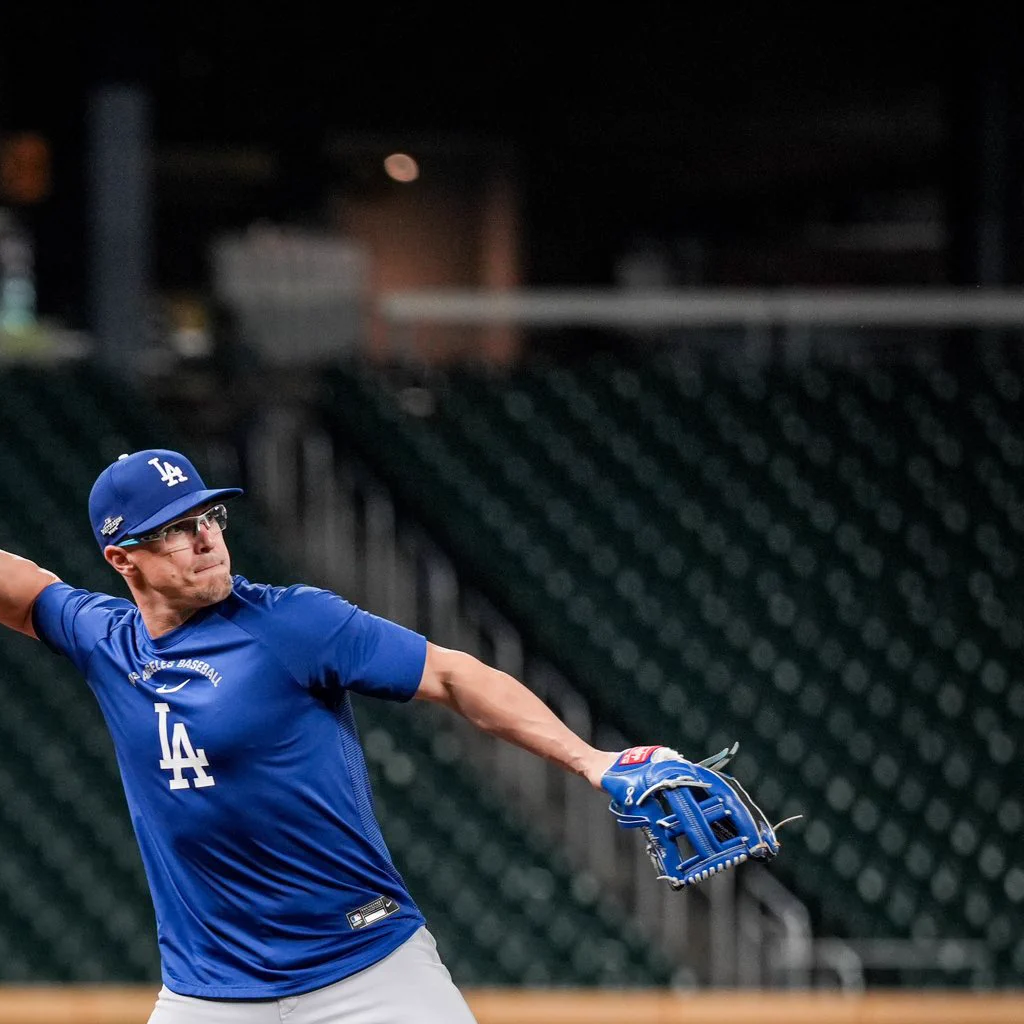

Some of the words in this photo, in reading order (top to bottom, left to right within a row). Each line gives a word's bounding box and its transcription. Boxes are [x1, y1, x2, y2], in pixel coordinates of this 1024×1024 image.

[147, 457, 189, 487] LA
[176, 659, 223, 688] BASEBALL
[154, 702, 216, 790] LA
